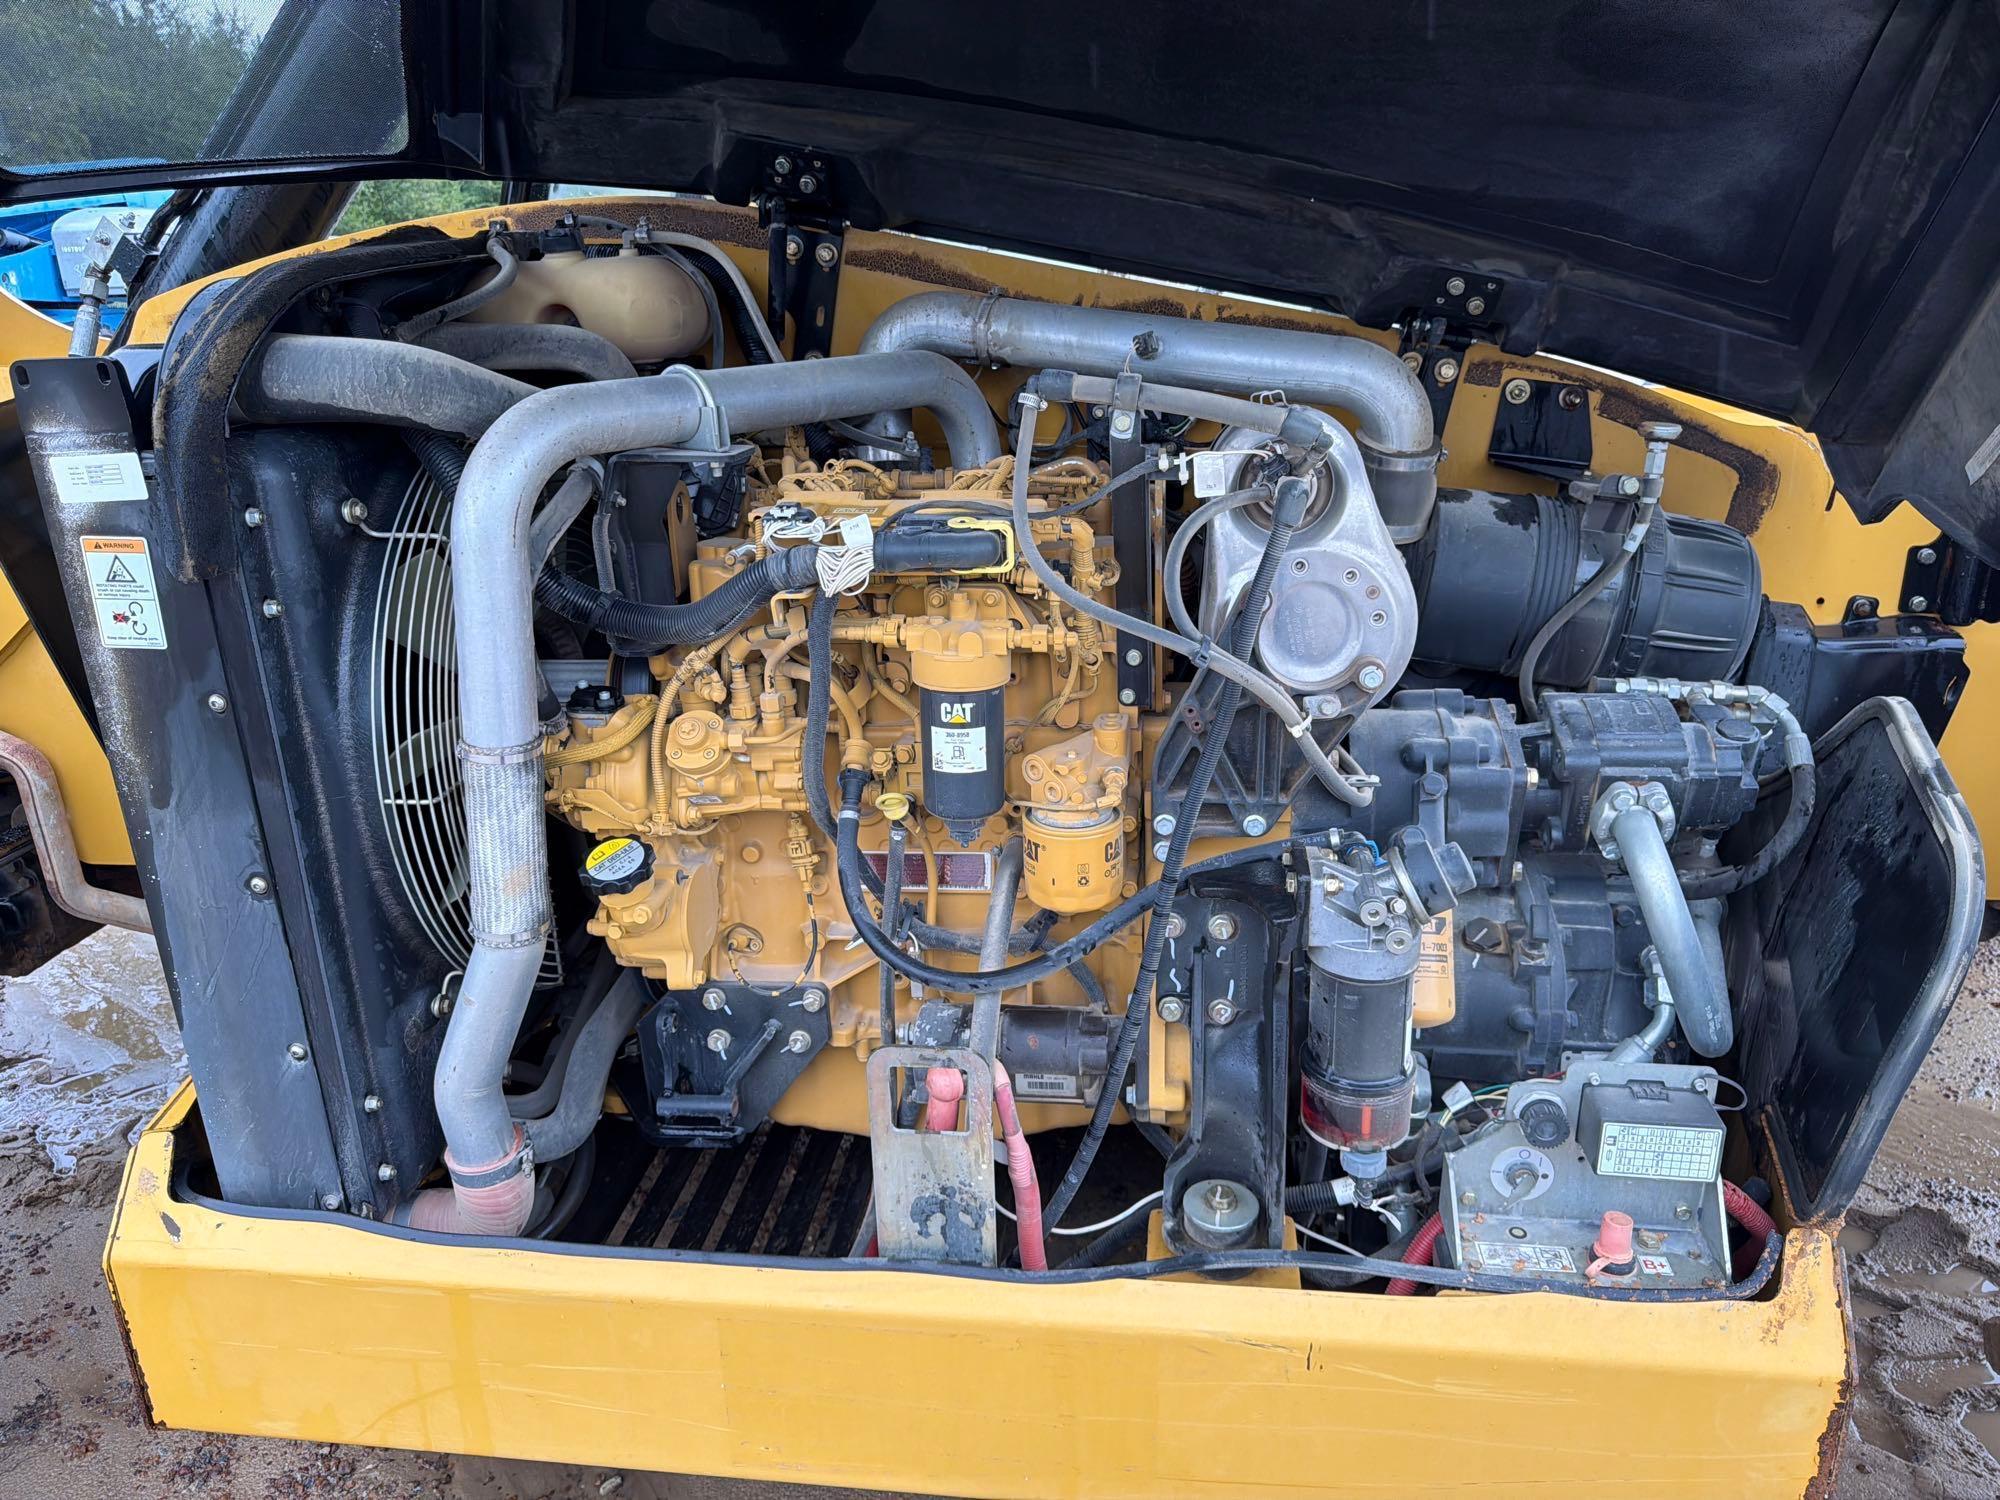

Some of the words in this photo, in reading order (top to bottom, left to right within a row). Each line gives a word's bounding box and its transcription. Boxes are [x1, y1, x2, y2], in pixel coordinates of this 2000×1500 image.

[940, 702, 974, 723] CAT
[594, 863, 606, 872] CAT
[1642, 1258, 1667, 1271] B+
